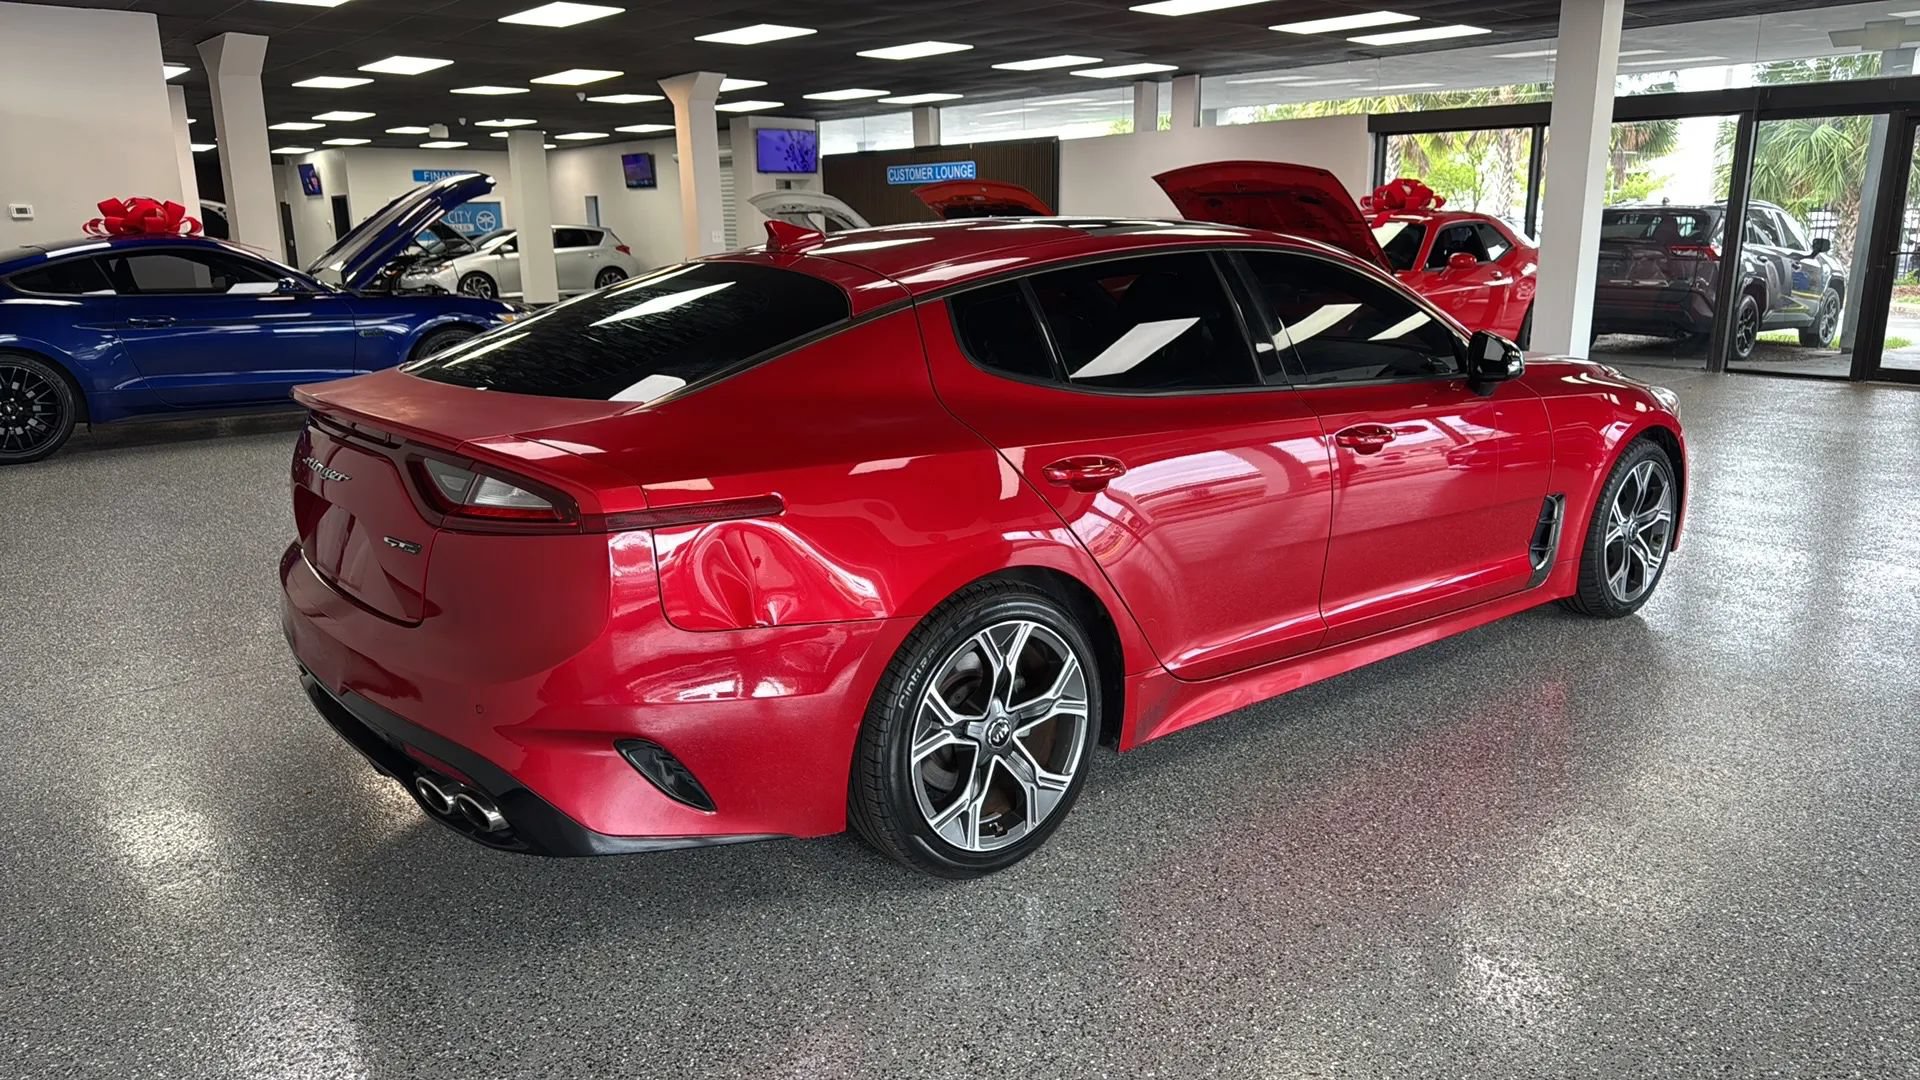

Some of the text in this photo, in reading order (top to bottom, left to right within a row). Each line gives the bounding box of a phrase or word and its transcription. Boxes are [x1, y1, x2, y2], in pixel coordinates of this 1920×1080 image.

[423, 171, 459, 181] FINAN
[889, 164, 973, 181] CUSTOMER LOUNGE
[447, 210, 471, 222] CITY
